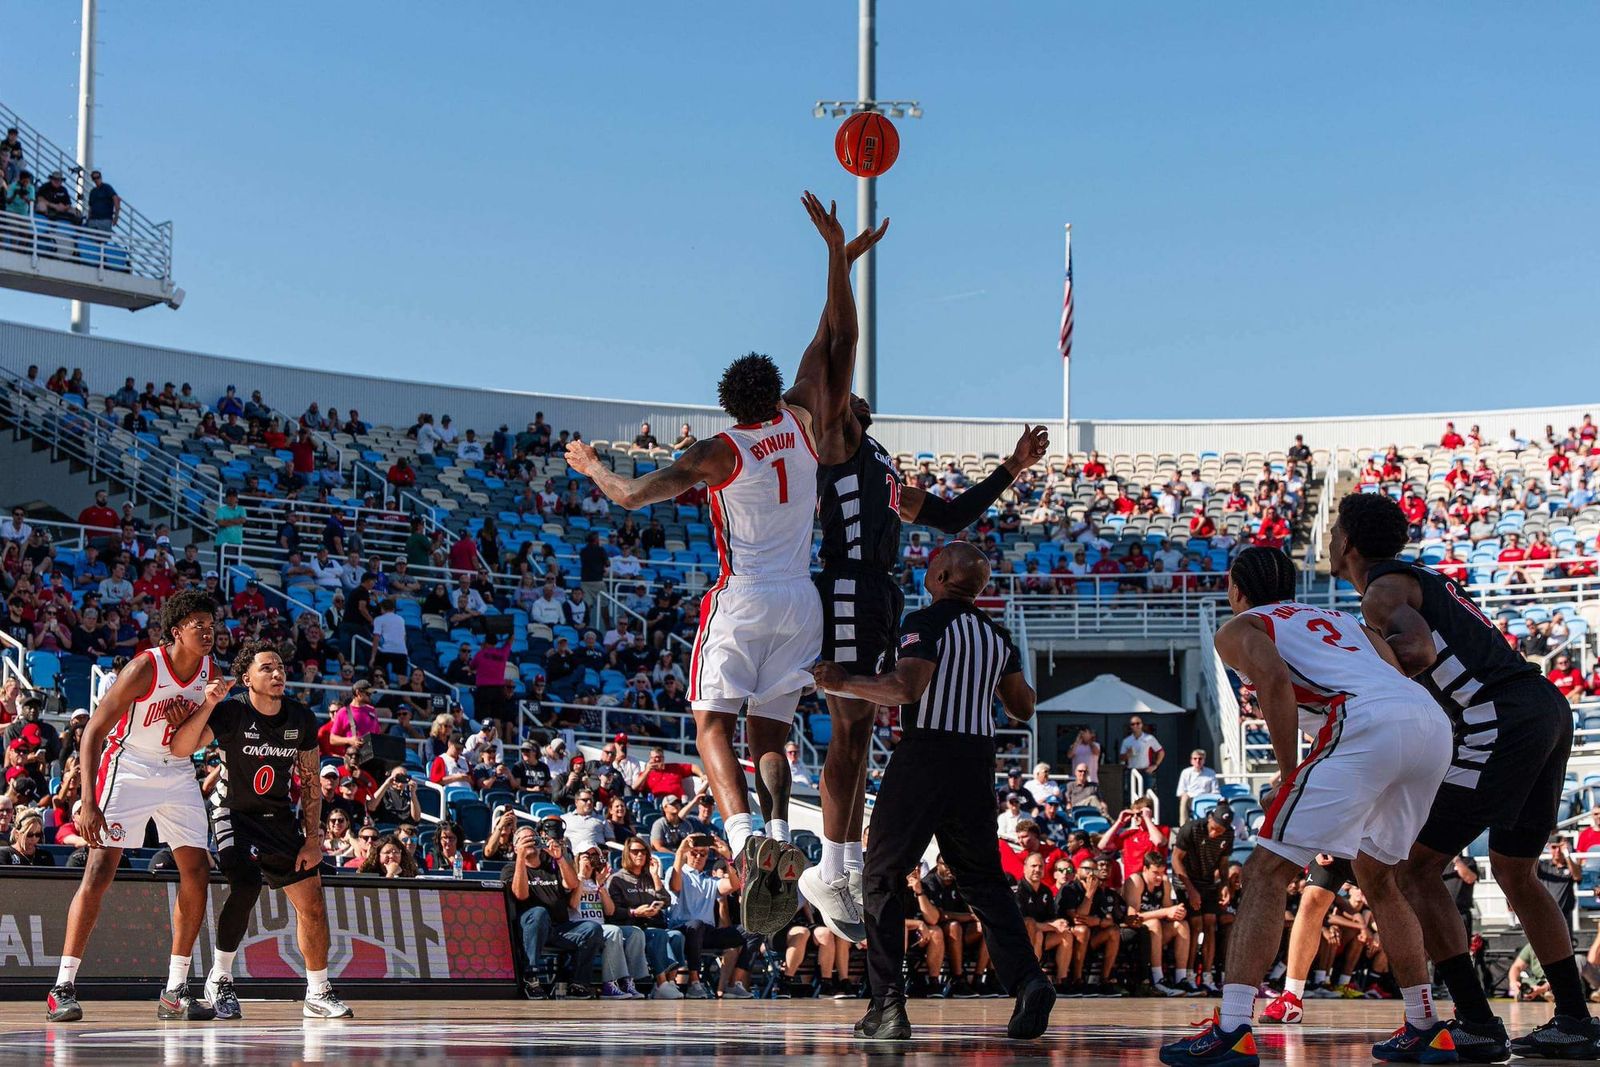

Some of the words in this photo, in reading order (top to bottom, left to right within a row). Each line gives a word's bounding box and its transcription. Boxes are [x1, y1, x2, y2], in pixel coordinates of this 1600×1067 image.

[750, 433, 795, 461] BYNUM
[771, 457, 789, 504] 1
[1306, 617, 1361, 652] 2
[242, 742, 298, 757] CINCINNATI
[253, 764, 275, 795] 0
